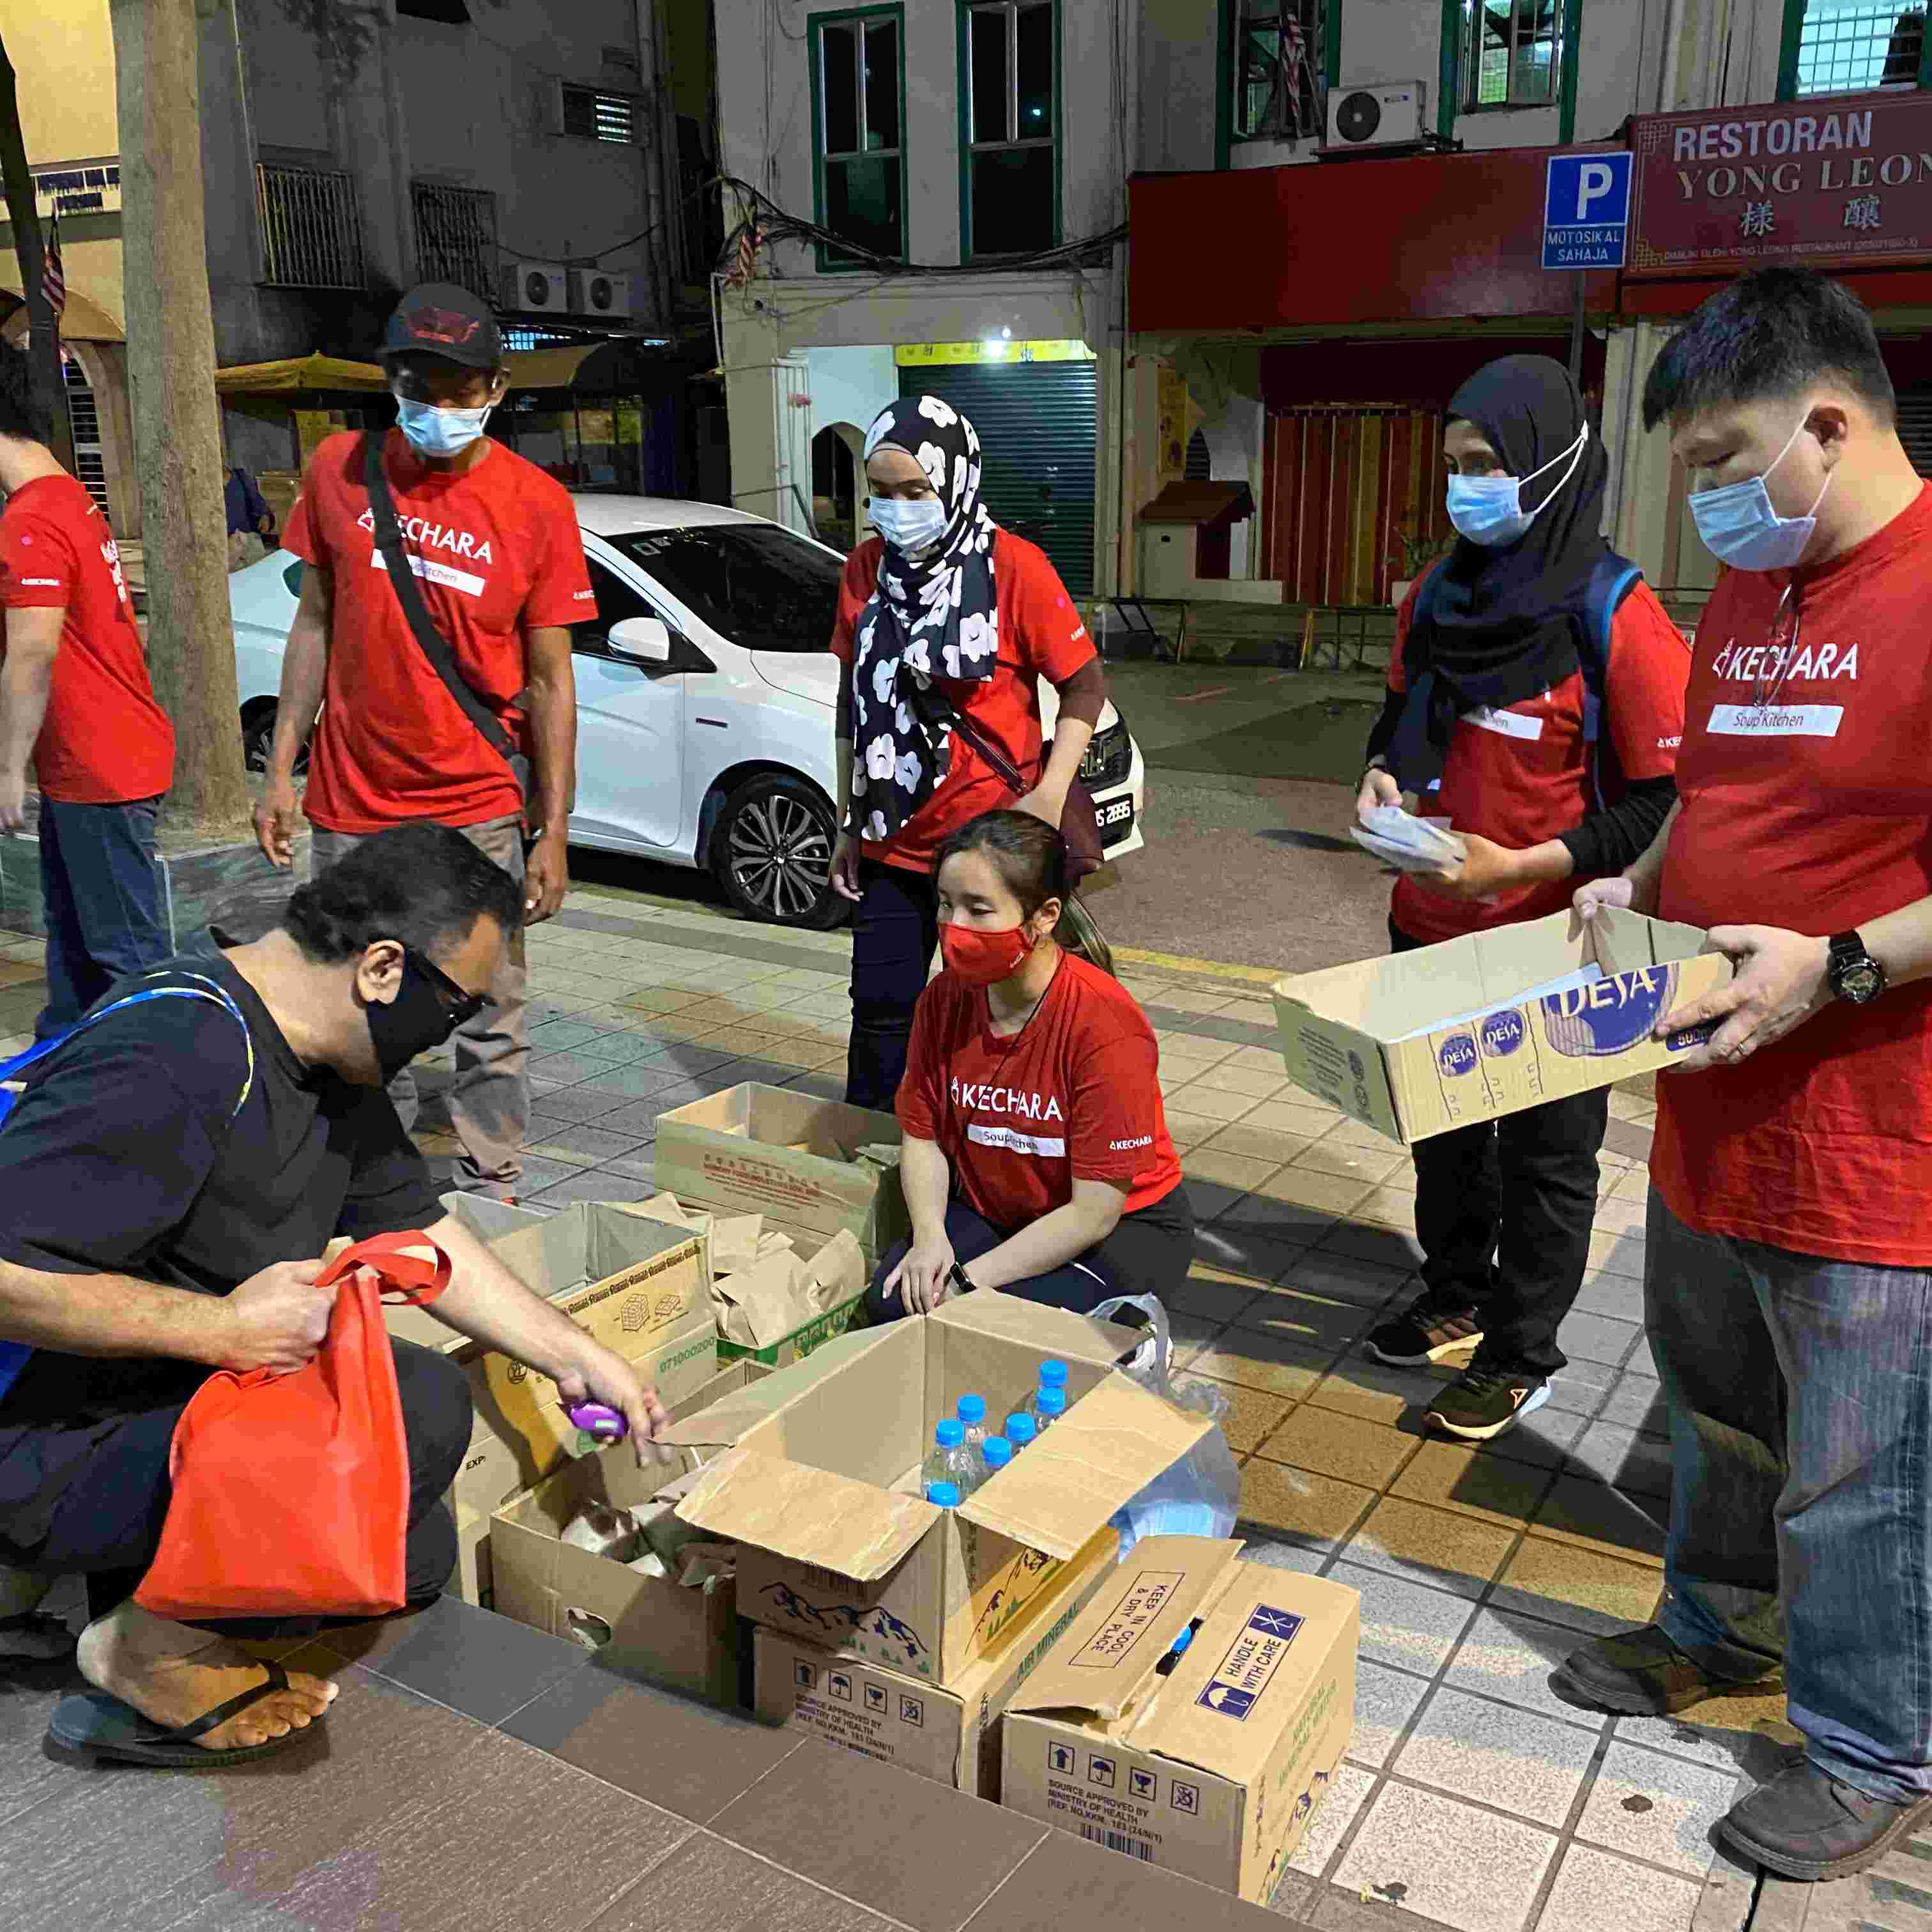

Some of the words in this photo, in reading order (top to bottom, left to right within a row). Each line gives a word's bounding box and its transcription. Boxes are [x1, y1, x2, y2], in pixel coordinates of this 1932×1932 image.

[1674, 111, 1873, 162] RESTORAN
[1577, 164, 1613, 219] P
[1677, 162, 1802, 199] YONG
[1548, 230, 1621, 245] MOTOSIKAL
[1558, 247, 1609, 261] SAHAJA
[394, 513, 493, 565] ECHARA
[1725, 643, 1859, 680] KECHARA
[1733, 712, 1759, 730] Soup
[1761, 714, 1804, 726] Kitchen
[1666, 737, 1683, 747] KE
[962, 1083, 1064, 1121] KECHARA
[983, 1131, 1012, 1146] Soup
[1116, 1135, 1153, 1150] KECHARA
[1120, 1599, 1142, 1618] DRY
[1144, 1584, 1169, 1610] KEEP
[1130, 1616, 1148, 1625] IN
[1091, 1623, 1123, 1651] PLACE
[1105, 1630, 1135, 1654] COOL
[1225, 1637, 1258, 1676] HANDLE
[1241, 1664, 1266, 1689] WITH
[1256, 1638, 1281, 1666] CARE
[1048, 1779, 1084, 1795] SOURCE
[1086, 1791, 1134, 1813] APPROVED
[1136, 1807, 1150, 1817] BY
[1089, 1802, 1102, 1812] OF
[1104, 1808, 1138, 1825] HEALTH
